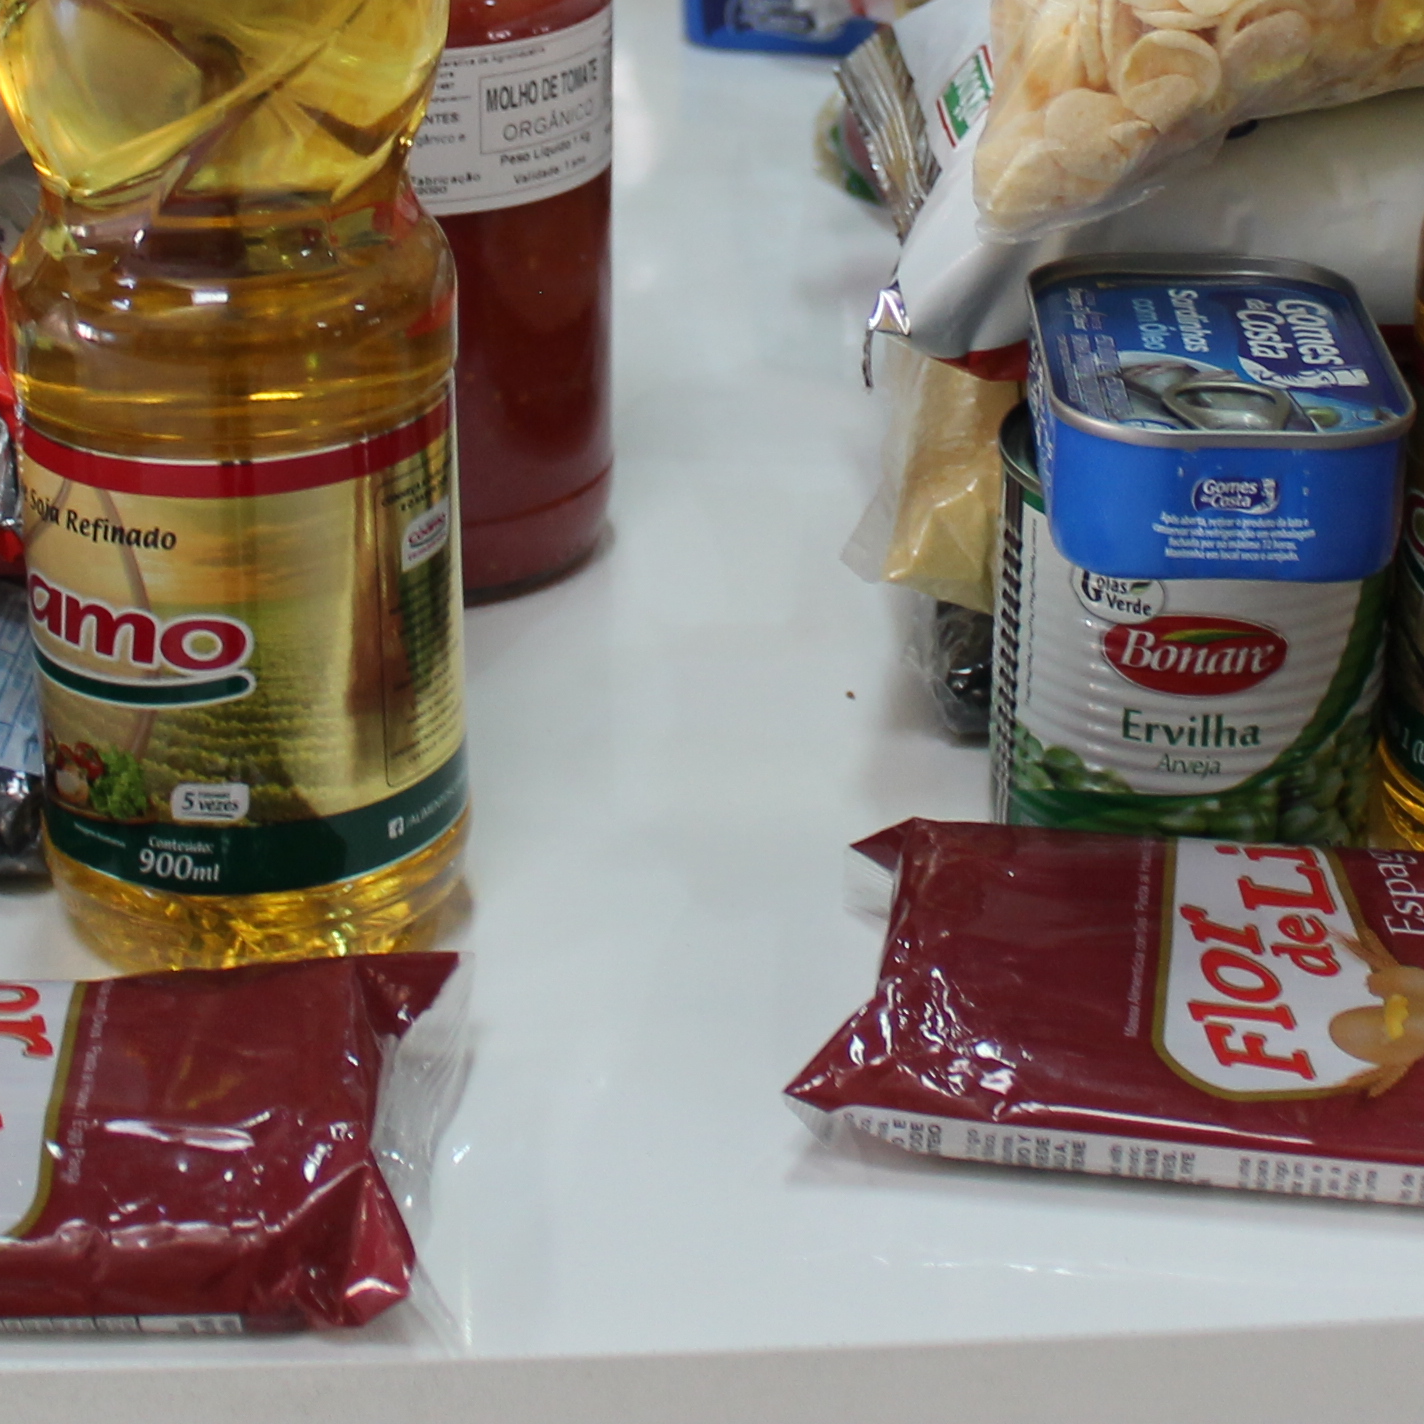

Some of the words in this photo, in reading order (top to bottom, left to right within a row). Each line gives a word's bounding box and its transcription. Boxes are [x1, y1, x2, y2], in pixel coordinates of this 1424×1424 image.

[486, 79, 537, 113] MOLHO
[542, 77, 557, 102] DE
[560, 56, 598, 92] TOMATE
[1168, 288, 1210, 353] Sardinhas
[1237, 310, 1293, 359] Costa
[1277, 298, 1344, 365] Gomes
[1202, 478, 1259, 495] Gomes
[1211, 493, 1253, 508] Costa
[66, 508, 178, 552] Refinado
[1106, 591, 1153, 616] Verde
[1120, 628, 1276, 675] Bonare
[1121, 707, 1262, 748] Ervilha
[1159, 753, 1222, 778] Arveja
[181, 791, 196, 811] 5
[139, 847, 221, 883] 900ml
[1270, 913, 1342, 978] de
[1180, 904, 1316, 1081] Flor
